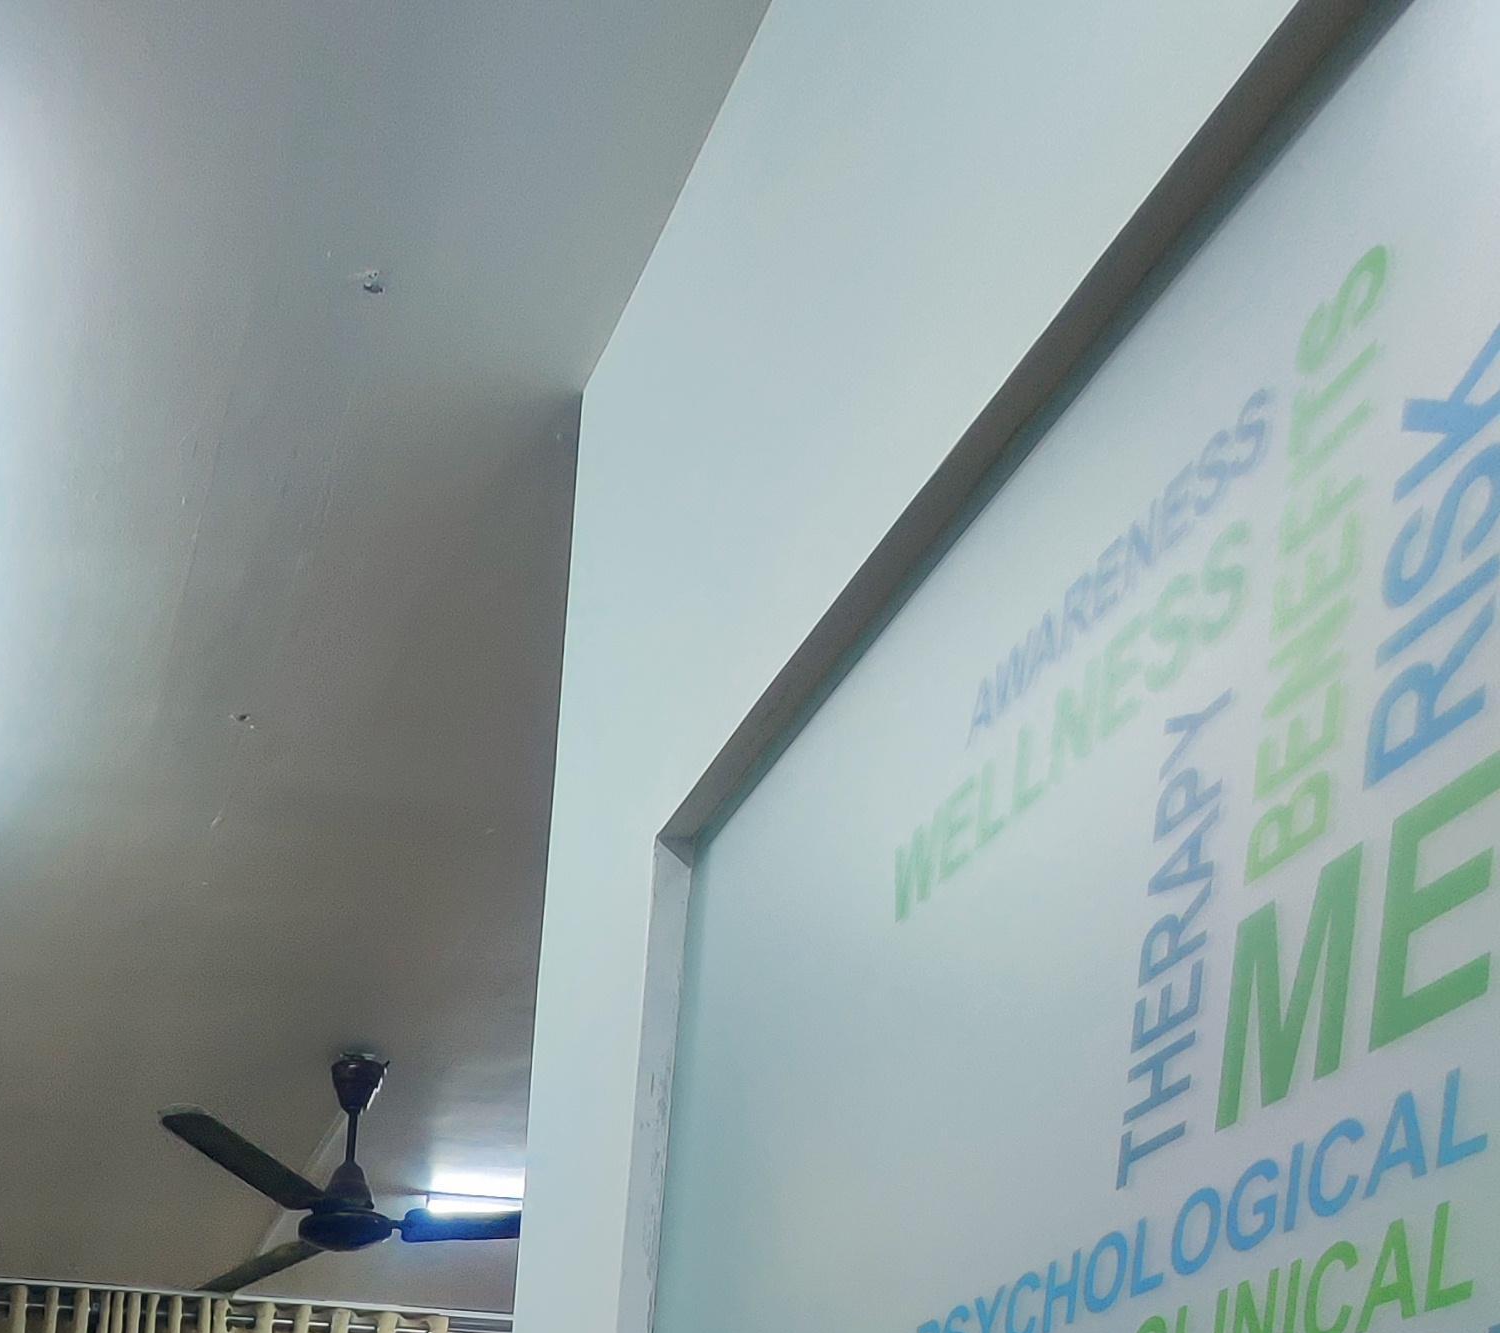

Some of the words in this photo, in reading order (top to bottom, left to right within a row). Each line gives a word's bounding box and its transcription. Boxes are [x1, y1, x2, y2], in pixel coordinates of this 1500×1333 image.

[894, 520, 1252, 924] WELLNESS
[966, 385, 1276, 750] AWARENESS
[1243, 244, 1389, 887] BENEFITS
[1363, 321, 1500, 791] RISK
[1115, 688, 1233, 1191] THERAPY
